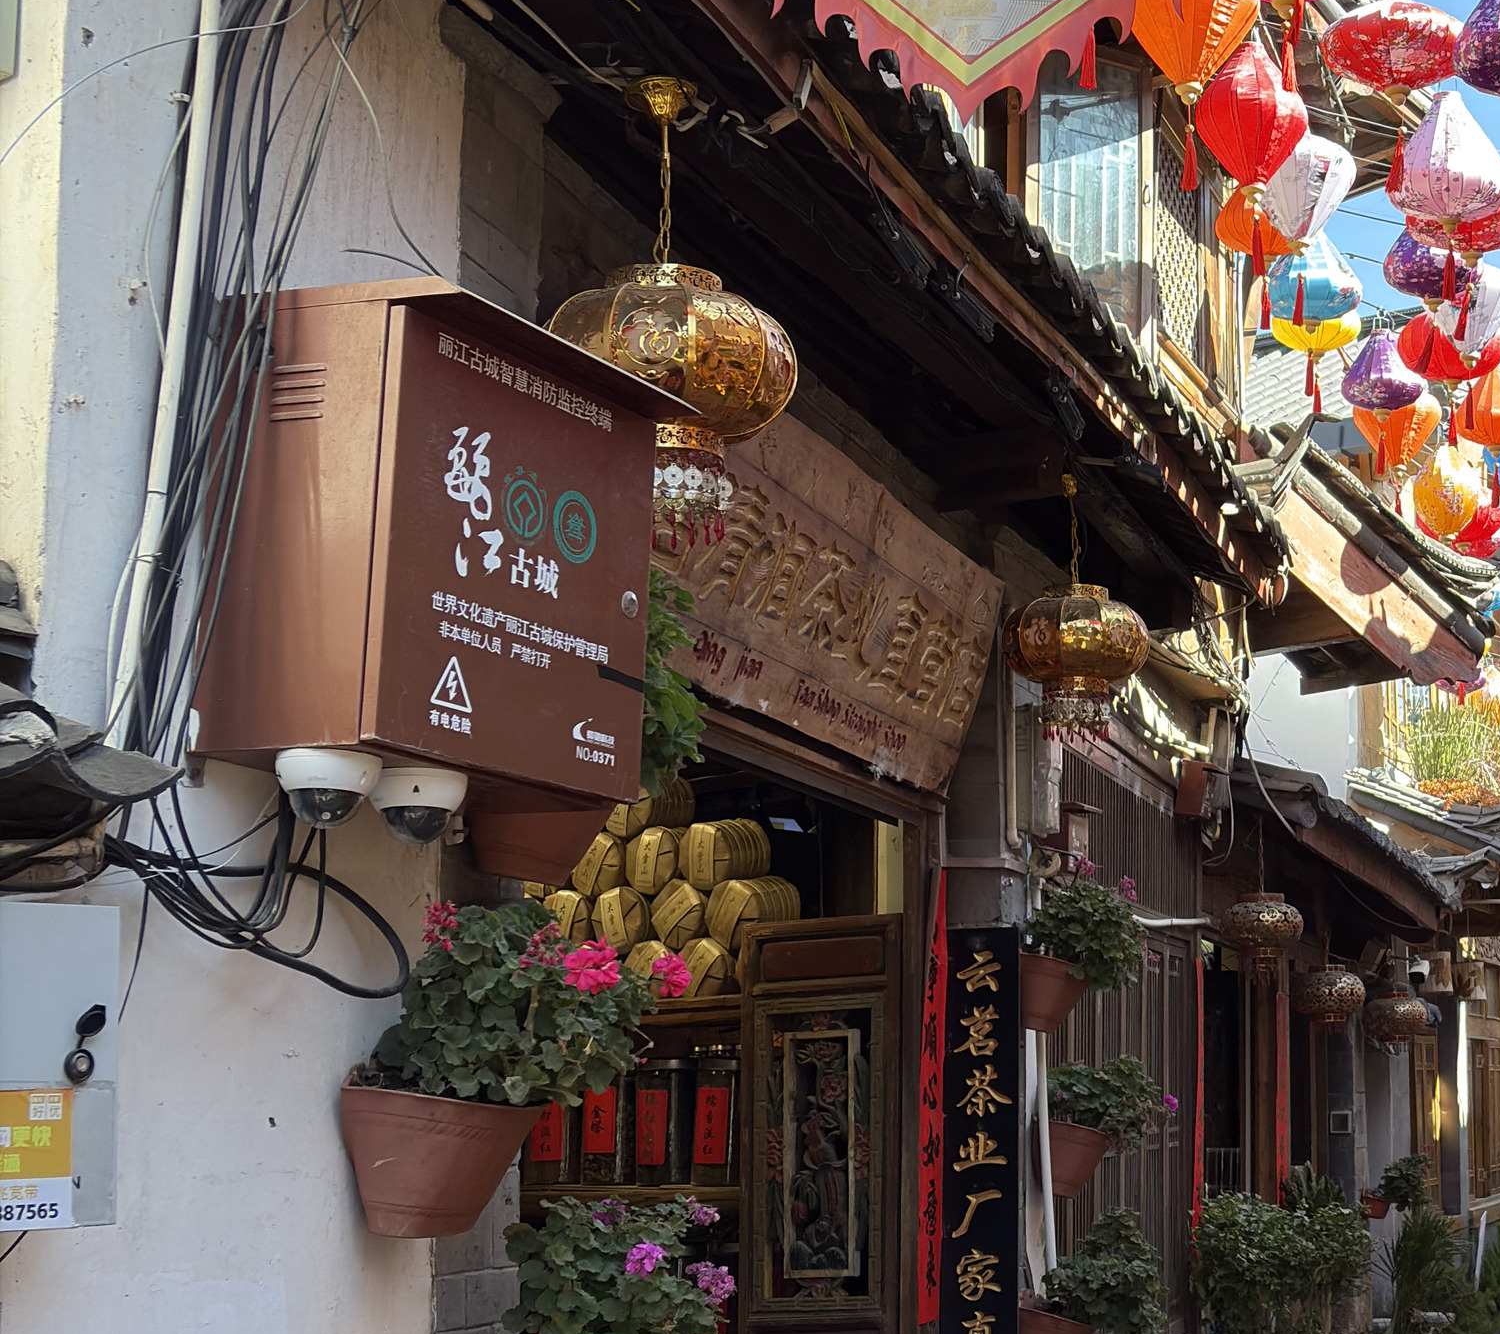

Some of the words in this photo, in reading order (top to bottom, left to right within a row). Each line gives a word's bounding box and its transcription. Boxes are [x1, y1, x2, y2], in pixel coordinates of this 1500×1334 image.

[438, 331, 613, 433] 丽江古城智慧消防监控终端
[508, 547, 560, 599] 古城
[431, 590, 609, 665] 世界文化遗产丽江古城保护管理局
[438, 620, 502, 655] 非本单位人员
[510, 643, 551, 669] 严禁打开
[429, 709, 472, 735] 有电危险
[0, 1202, 59, 1221] 87565
